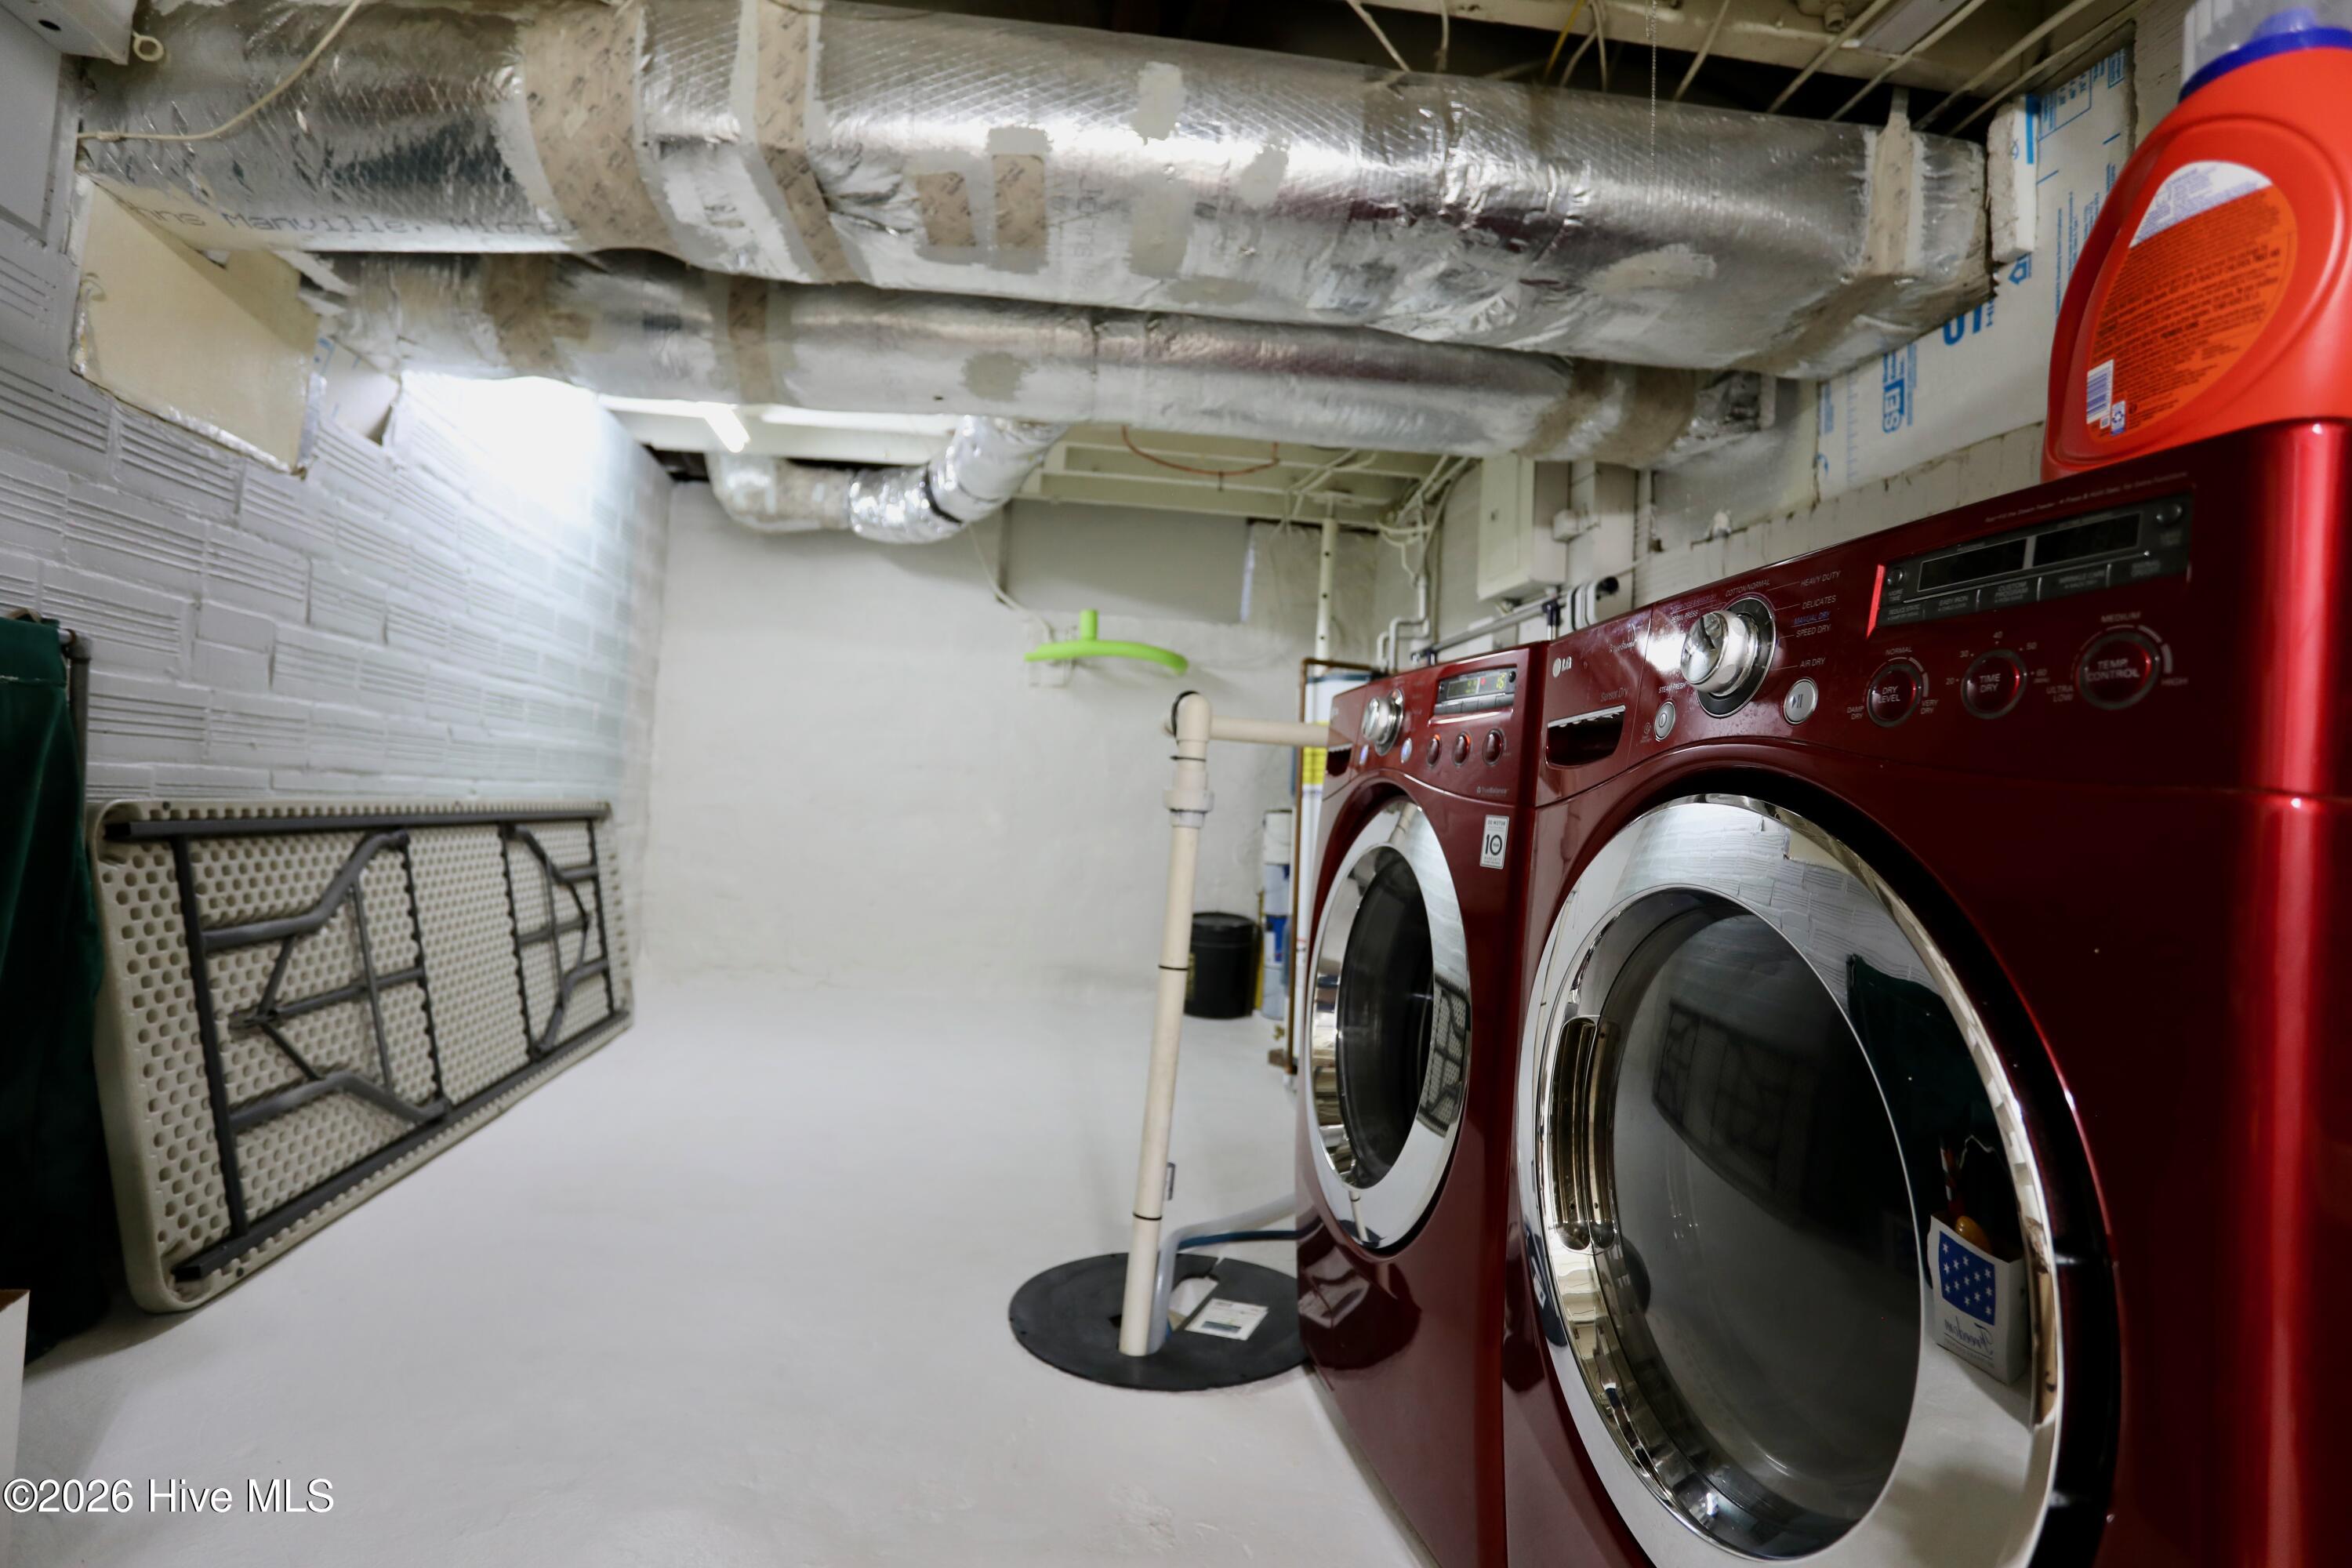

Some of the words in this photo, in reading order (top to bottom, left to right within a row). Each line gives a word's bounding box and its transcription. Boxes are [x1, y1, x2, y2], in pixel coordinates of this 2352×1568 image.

[1800, 575, 1821, 587] HEAVY
[1822, 570, 1841, 583] DUTY
[1802, 594, 1837, 610] DELICATES
[1796, 626, 1817, 637] SPEED
[1817, 624, 1831, 634] DRY
[1885, 646, 1913, 655] NORMAL
[1811, 657, 1826, 666] DRY
[1979, 673, 2001, 684] TIME
[2087, 668, 2140, 682] CONTROL
[1882, 686, 1899, 695] DRY
[1980, 683, 1999, 694] DRY
[1600, 689, 1618, 702] Sensor
[1617, 687, 1629, 699] Dry
[1879, 694, 1900, 704] LEVEL
[2053, 694, 2074, 702] LOW
[1485, 834, 1503, 856] 10
